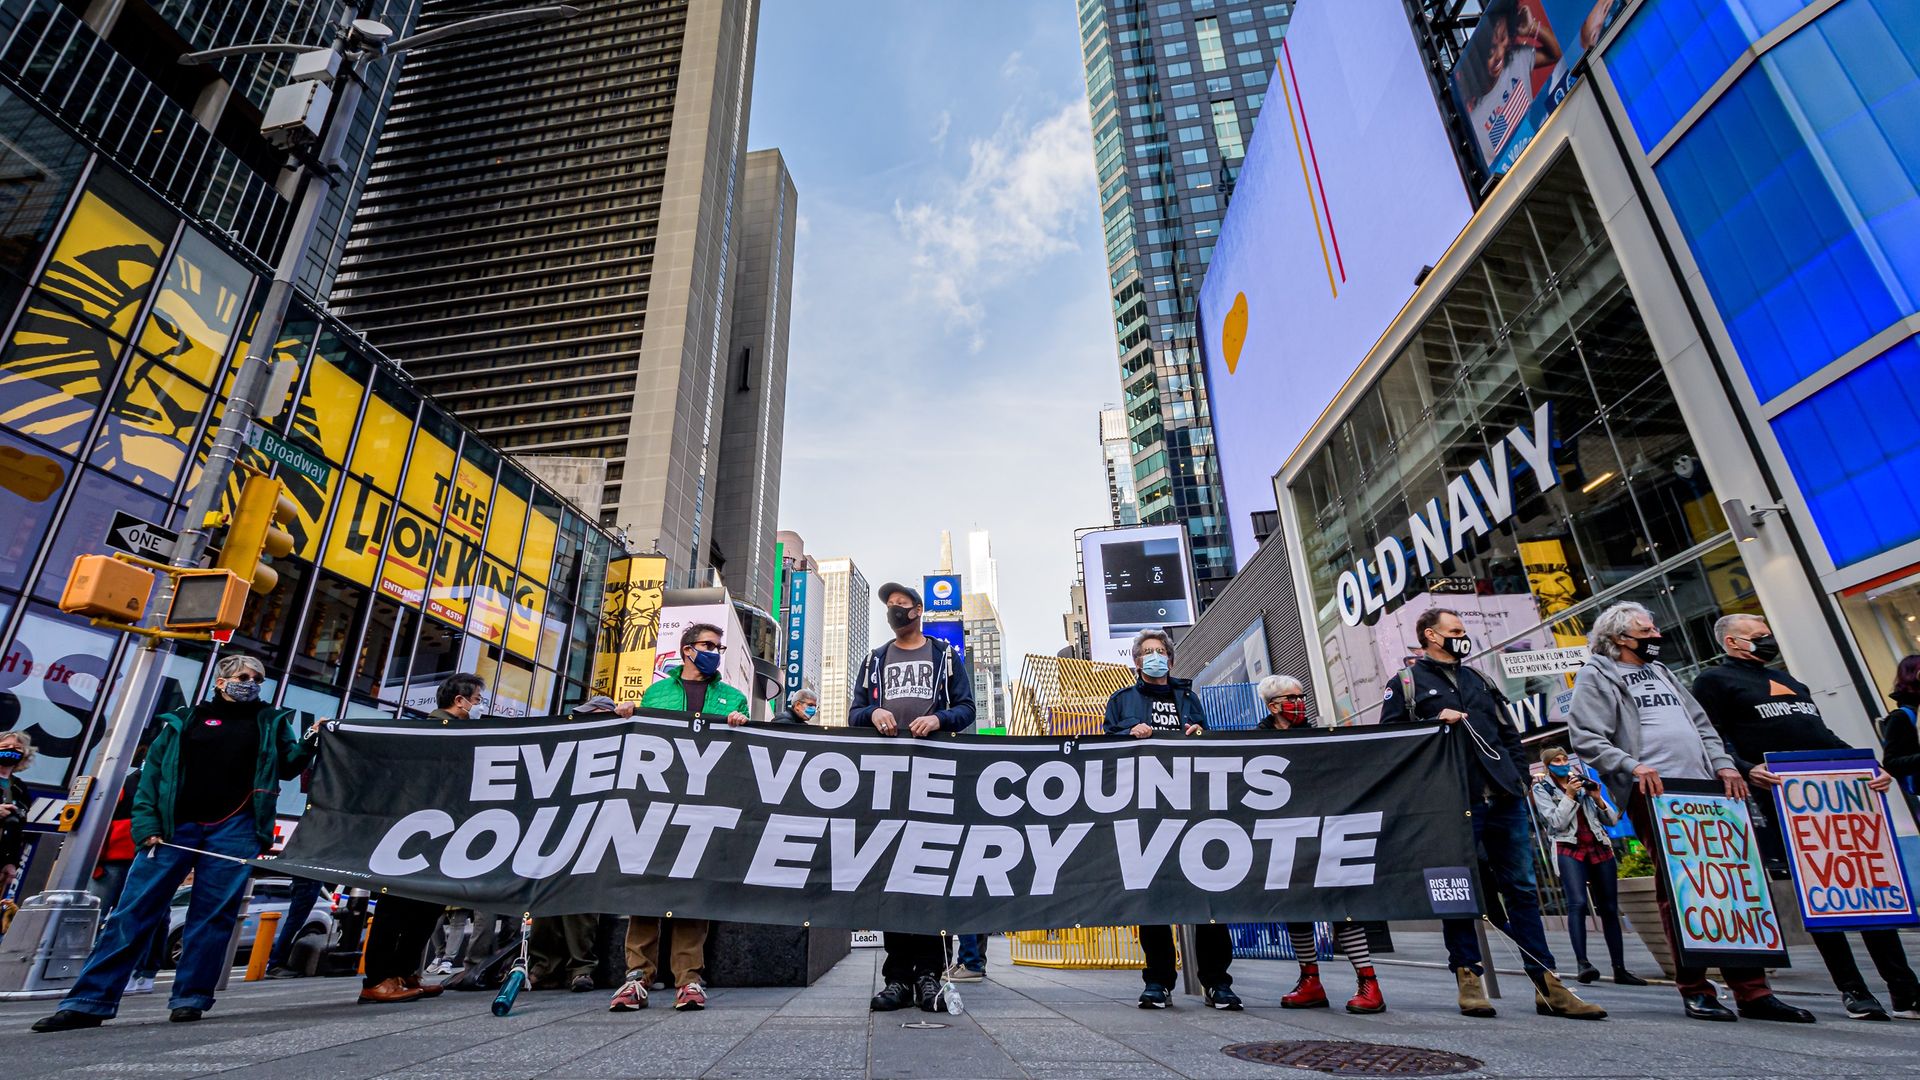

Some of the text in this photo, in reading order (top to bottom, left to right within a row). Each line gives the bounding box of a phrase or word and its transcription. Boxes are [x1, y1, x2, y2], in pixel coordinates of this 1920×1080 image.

[264, 436, 326, 483] Broadway
[433, 472, 487, 531] THE
[1337, 401, 1559, 627] OLD NAVY
[129, 529, 162, 551] ONE
[345, 473, 534, 623] LION KING
[431, 602, 443, 613] ON
[445, 608, 462, 622] 45TH
[470, 620, 490, 634] STREET
[790, 579, 803, 641] TIMES
[1452, 637, 1471, 654] VO
[1504, 649, 1583, 665] PEDESTRIAN FLOW ZONE
[624, 676, 643, 685] THE
[887, 663, 933, 689] RAR
[1508, 663, 1552, 675] KEEP MOVING
[910, 686, 931, 697] RESIST
[470, 733, 1292, 817] EVERY VOTE COUNTS
[1784, 777, 1876, 814] COUNT
[368, 798, 1384, 897] COUNT EVERY VOTE
[1662, 818, 1749, 861] EVERY
[1792, 814, 1881, 851] EVERY
[1429, 877, 1469, 889] RISE AND
[1680, 859, 1761, 902] VOTE
[1804, 851, 1891, 889] VOTE
[1431, 887, 1471, 901] RESIST
[1808, 885, 1906, 913] COUNTS
[854, 933, 878, 943] Leach
[1684, 905, 1780, 949] COUNTS
